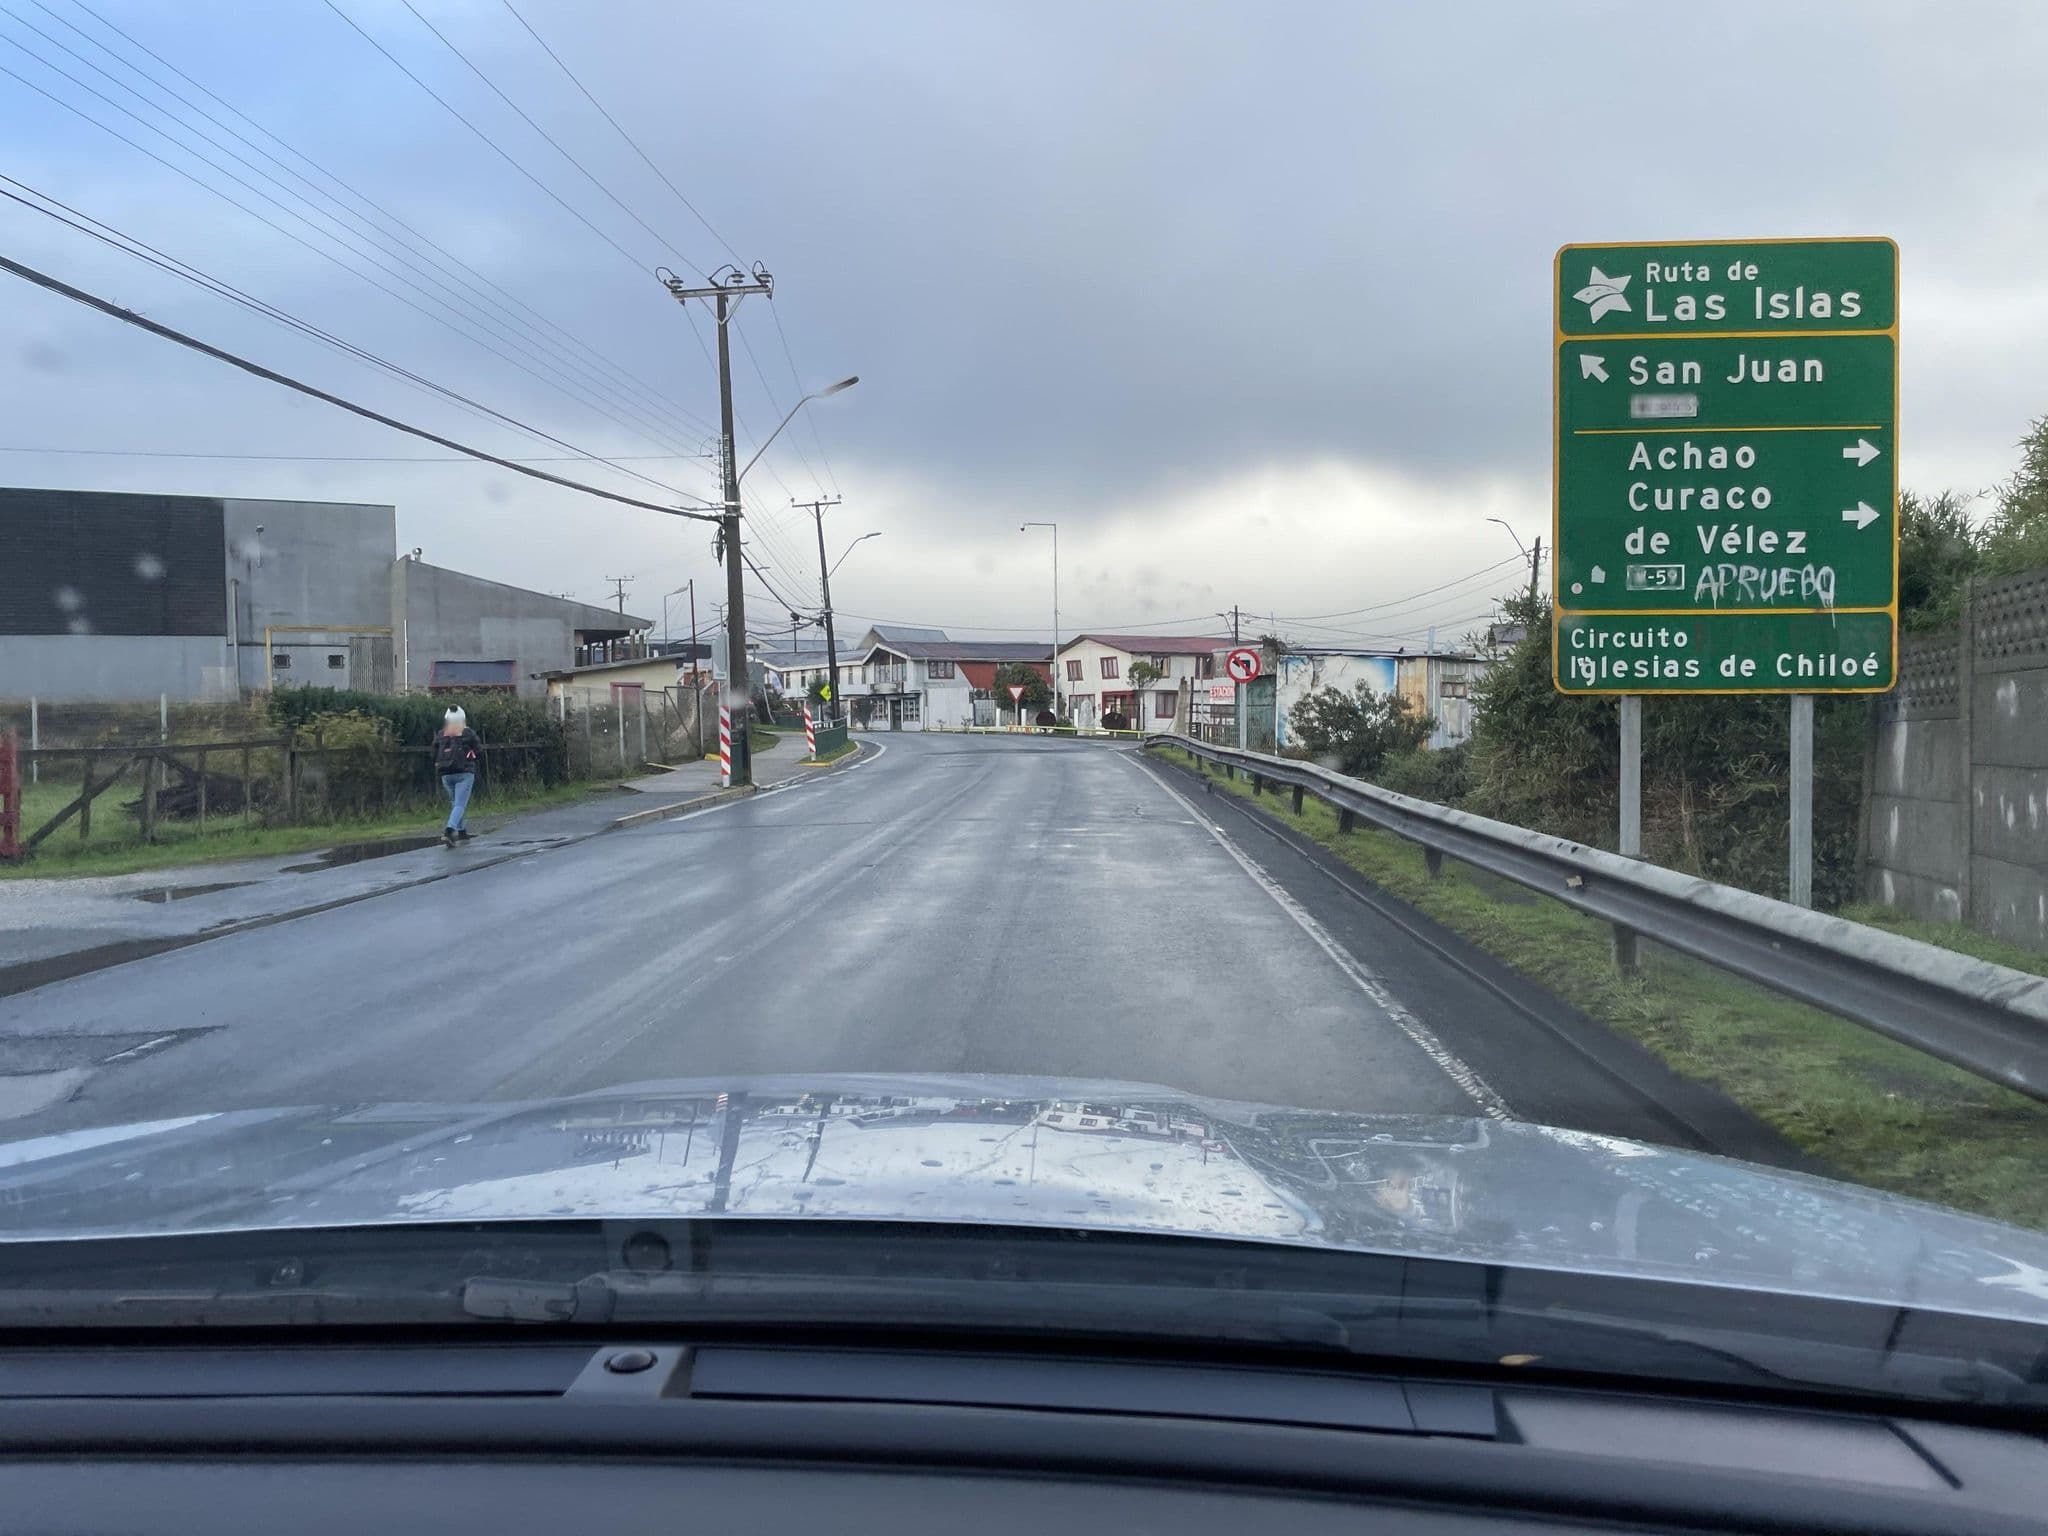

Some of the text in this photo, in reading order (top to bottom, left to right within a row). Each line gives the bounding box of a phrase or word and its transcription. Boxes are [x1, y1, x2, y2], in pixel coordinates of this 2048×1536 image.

[1646, 260, 1759, 283] Ruta de
[1646, 286, 1861, 322] Las Islas
[1628, 354, 1823, 386] San Juan
[1628, 441, 1756, 471] Achao
[1628, 482, 1772, 512] Curaco
[1625, 523, 1806, 555] de Vélez
[1694, 563, 1837, 606] APRUEBO
[1571, 627, 1688, 649] Circuito
[1570, 651, 1879, 687] Iglesias de Chiloé
